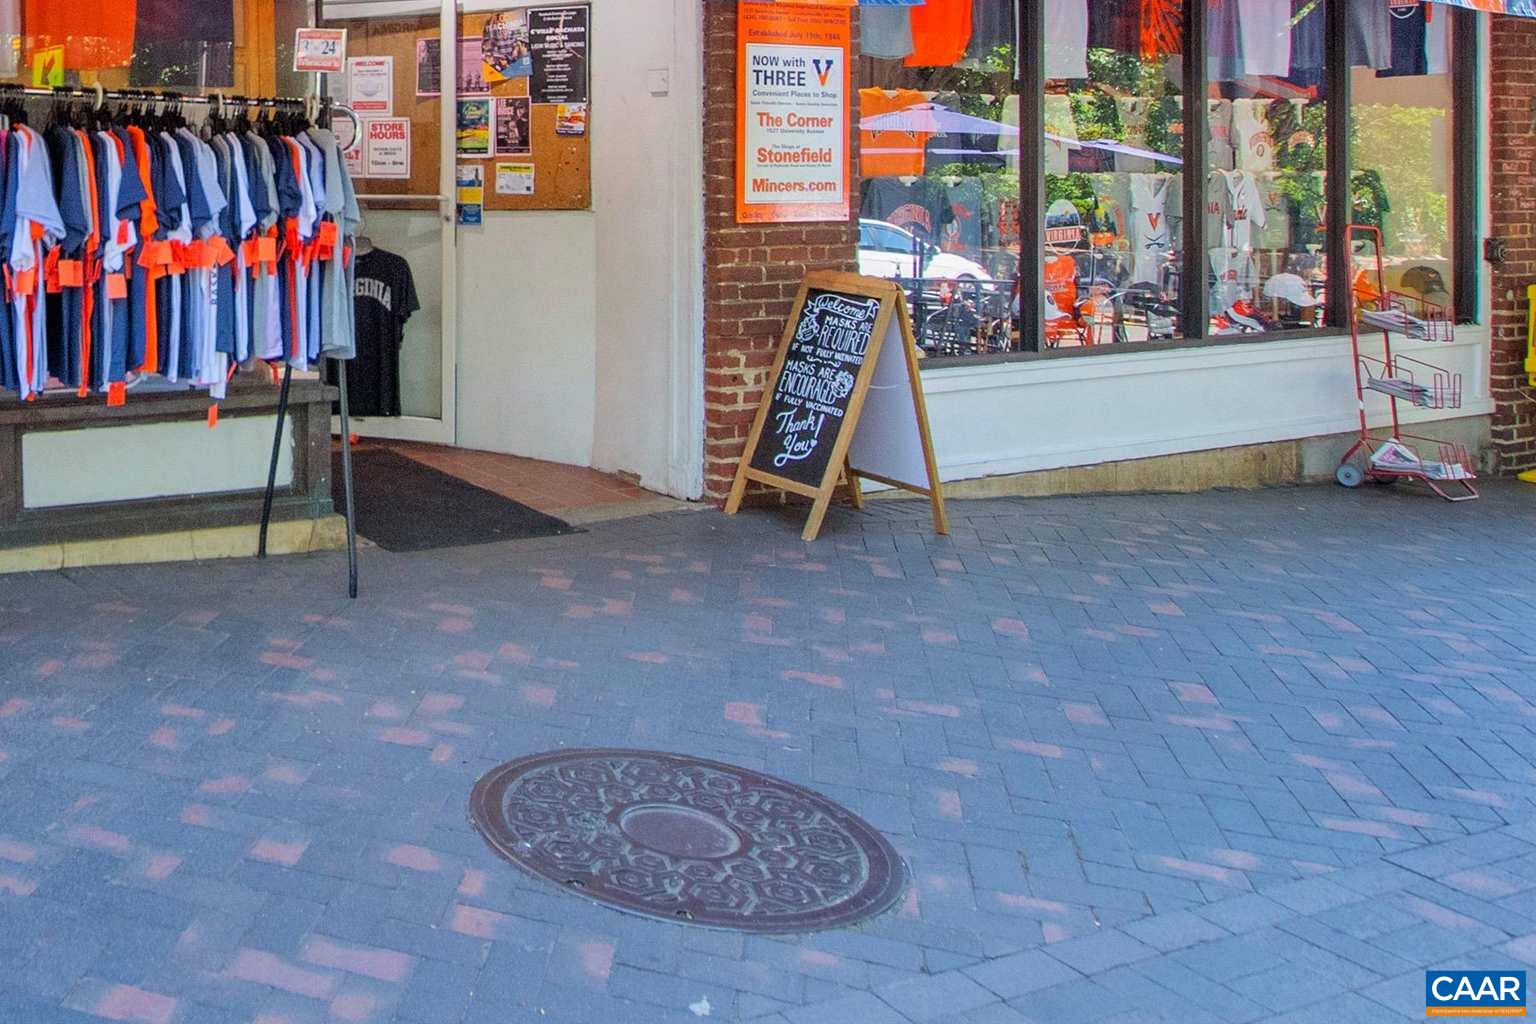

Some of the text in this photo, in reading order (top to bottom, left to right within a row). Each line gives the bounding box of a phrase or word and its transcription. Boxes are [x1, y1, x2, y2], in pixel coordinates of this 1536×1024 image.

[321, 40, 336, 55] 24
[753, 56, 805, 67] NOW with
[752, 70, 806, 86] THREE
[372, 123, 404, 131] STORE
[757, 112, 833, 127] The Corner
[370, 131, 405, 140] HOURS
[757, 148, 832, 163] Stonefield
[752, 179, 836, 192] Mincers.com
[1046, 228, 1082, 241] VIRGINIA
[817, 296, 865, 318] Welcome
[825, 316, 872, 333] MASKS ARE
[819, 325, 870, 355] REQUIRED
[792, 343, 834, 358] IF NOT FULLY
[786, 360, 836, 381] MASKS ARE
[779, 371, 836, 404] ENCOURAGED
[784, 395, 803, 406] FULLY
